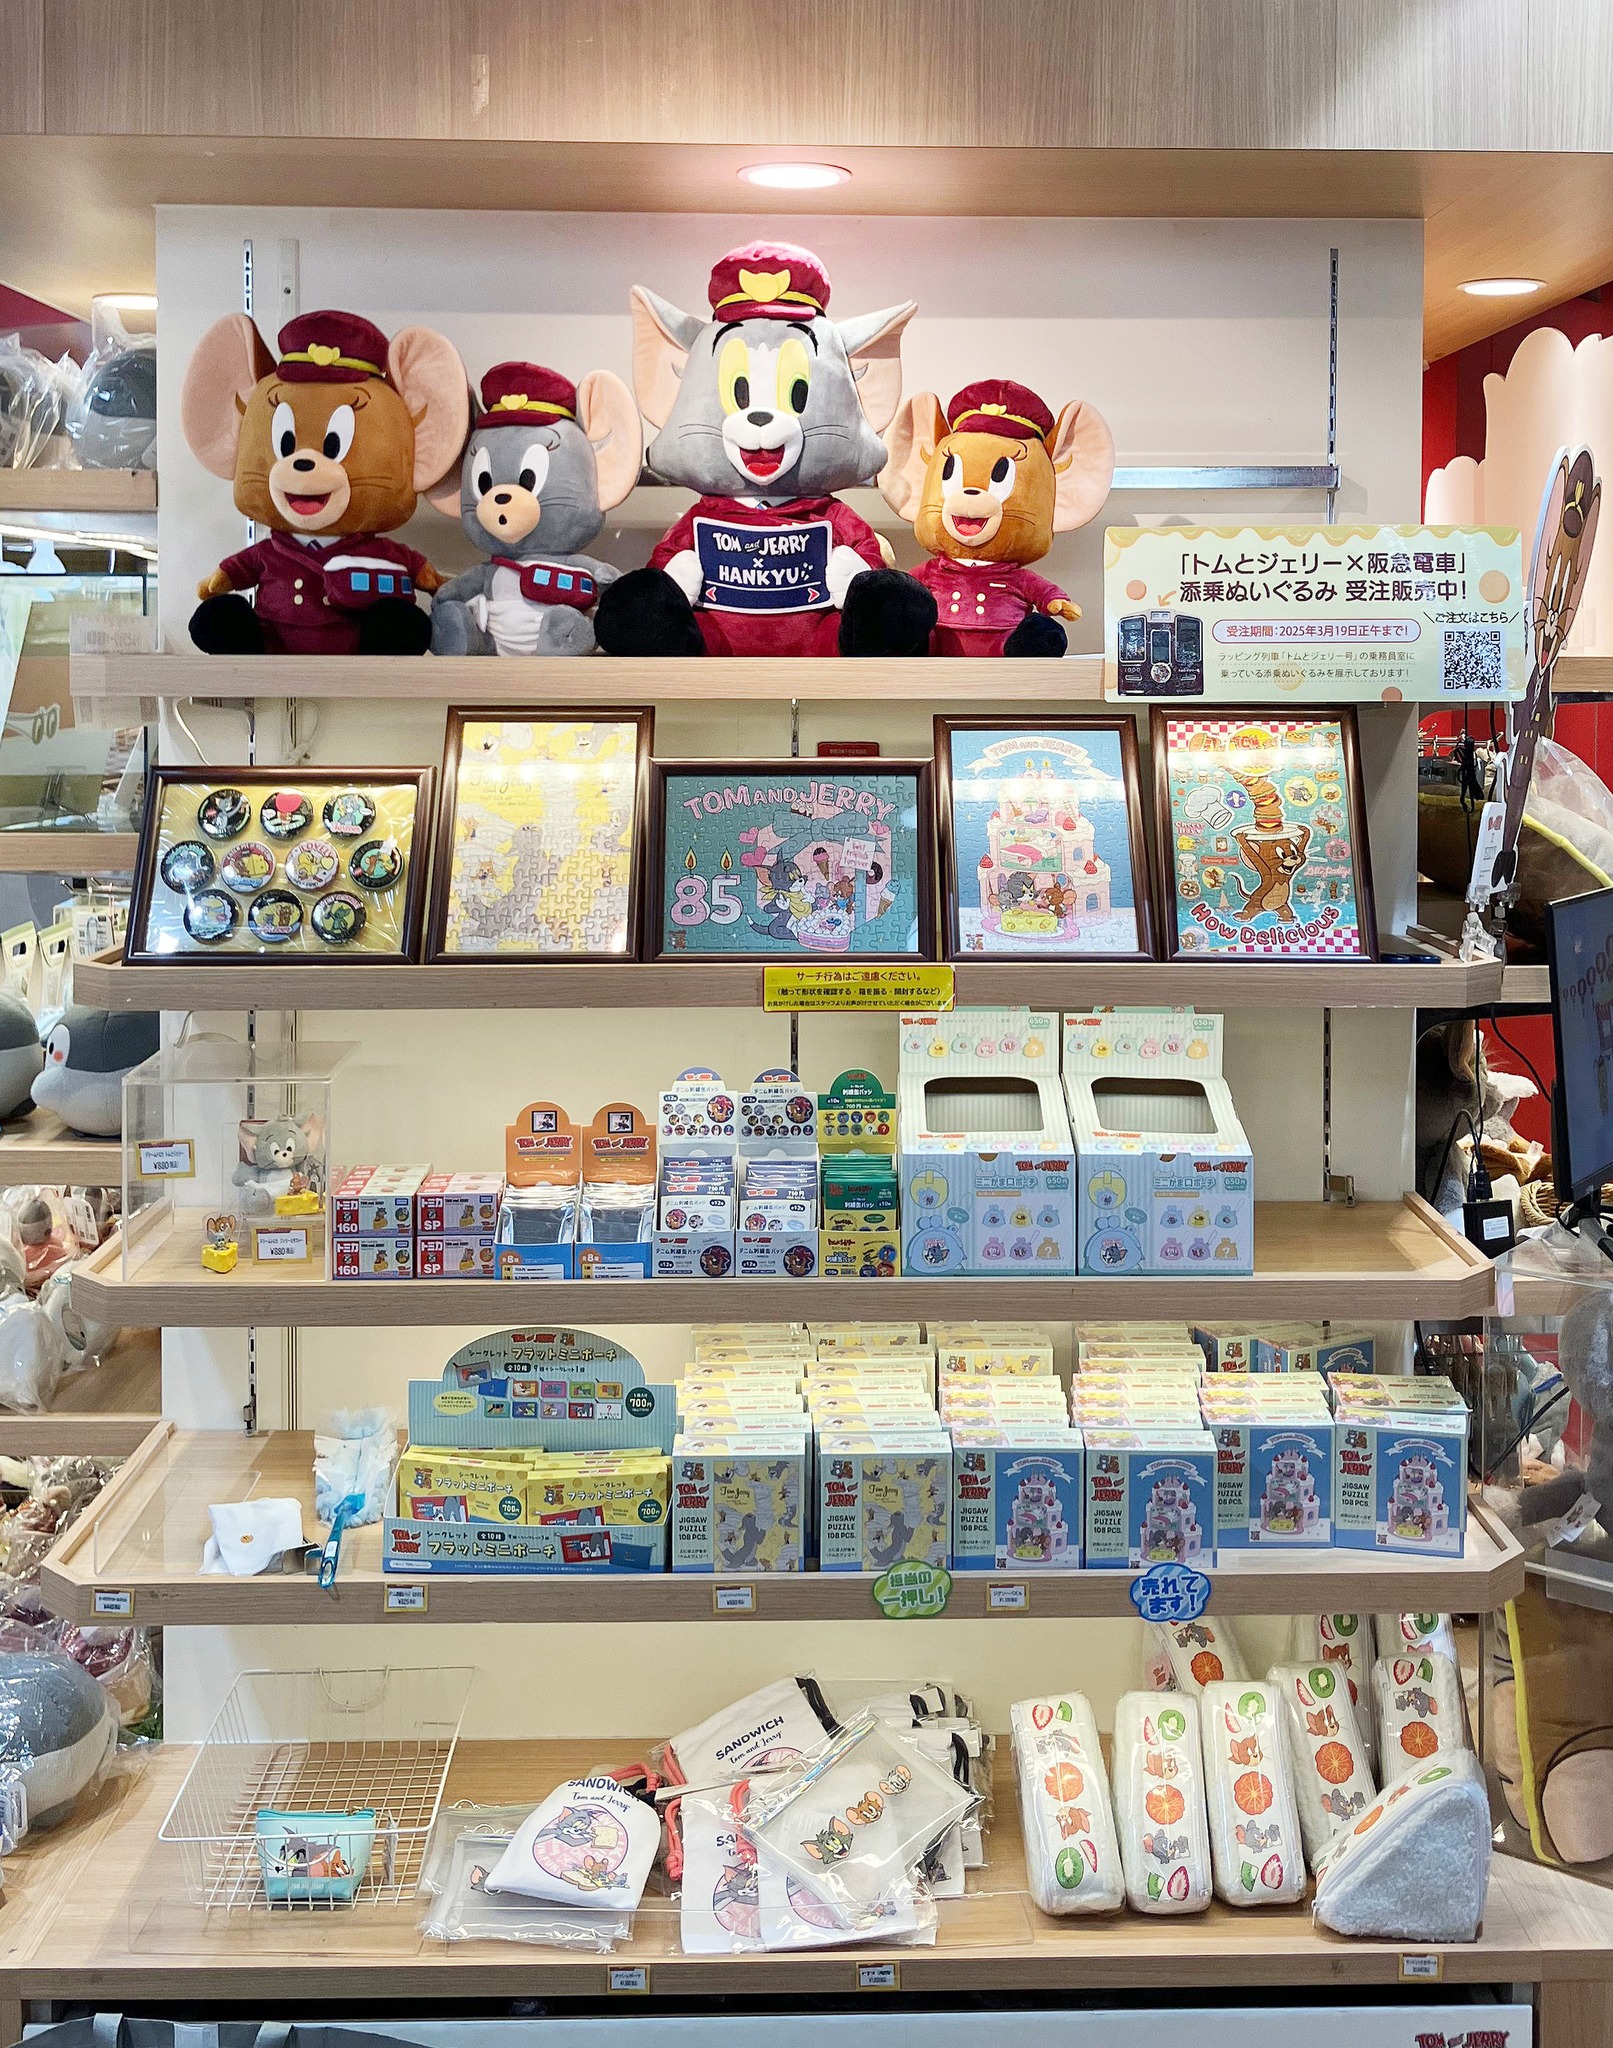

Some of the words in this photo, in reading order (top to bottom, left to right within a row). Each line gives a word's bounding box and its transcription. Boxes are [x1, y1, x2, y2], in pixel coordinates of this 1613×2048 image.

[713, 532, 742, 552] TOM
[745, 540, 760, 552] and
[758, 534, 810, 556] JERRY
[1181, 552, 1467, 574] 「トムとジェリー×阪急電車」
[719, 564, 799, 586] HANKYU
[1180, 580, 1338, 602] 添乗ぬいぐるみ
[989, 741, 1018, 757] TOM
[1040, 739, 1083, 758] JERRY
[684, 784, 750, 820] TOM
[753, 786, 799, 805] AND
[798, 781, 896, 821] JERRY
[670, 873, 744, 926] 85
[1191, 903, 1237, 940] How
[1240, 905, 1341, 945] Delicious
[796, 971, 921, 982] サーチ行為はご遠慮ください。
[516, 1136, 535, 1149] TOM
[544, 1136, 572, 1149] JERRY
[592, 1137, 611, 1149] TOM
[620, 1137, 648, 1150] JERRY
[337, 1200, 358, 1210] トミカ
[421, 1198, 443, 1208] トミカ
[337, 1223, 358, 1233] 160
[424, 1220, 441, 1231] SP
[337, 1242, 358, 1252] トミカ
[421, 1241, 443, 1251] トミカ
[337, 1265, 358, 1275] 160
[423, 1264, 441, 1274] SP
[468, 1350, 509, 1358] シークレット
[511, 1347, 617, 1362] フラットミニポーチ
[629, 1399, 652, 1408] 700円
[1339, 1449, 1360, 1461] TOM
[1339, 1462, 1372, 1476] JERRY
[459, 1472, 489, 1480] シークレット
[958, 1474, 979, 1486] TOM
[1091, 1475, 1112, 1488] TOM
[435, 1477, 514, 1495] フラットミニポーチ
[676, 1483, 697, 1495] TOM
[824, 1481, 846, 1493] TOM
[567, 1488, 653, 1501] フラットミニポーチ
[958, 1487, 991, 1500] JERRY
[1091, 1489, 1124, 1502] JERRY
[1342, 1491, 1369, 1499] PUZZLE
[676, 1496, 709, 1509] JERRY
[824, 1494, 858, 1507] JERRY
[502, 1504, 520, 1513] 700円
[641, 1507, 660, 1515] 700円
[391, 1529, 410, 1541] TOM
[427, 1531, 469, 1539] シークレット
[427, 1541, 556, 1558] フラットミニポーチ
[889, 1571, 932, 1588] 担当の
[1141, 1576, 1199, 1596] 売れて
[883, 1586, 944, 1607] 一押し!
[1149, 1594, 1196, 1614] ます!
[715, 1715, 785, 1761] SANDWICH
[728, 1752, 746, 1764] Tom
[745, 1741, 760, 1755] and
[760, 1730, 783, 1746] Jerry
[572, 1791, 589, 1801] Tom
[590, 1793, 606, 1801] and
[607, 1793, 631, 1812] Jerry
[1414, 2032, 1446, 2048] TOM
